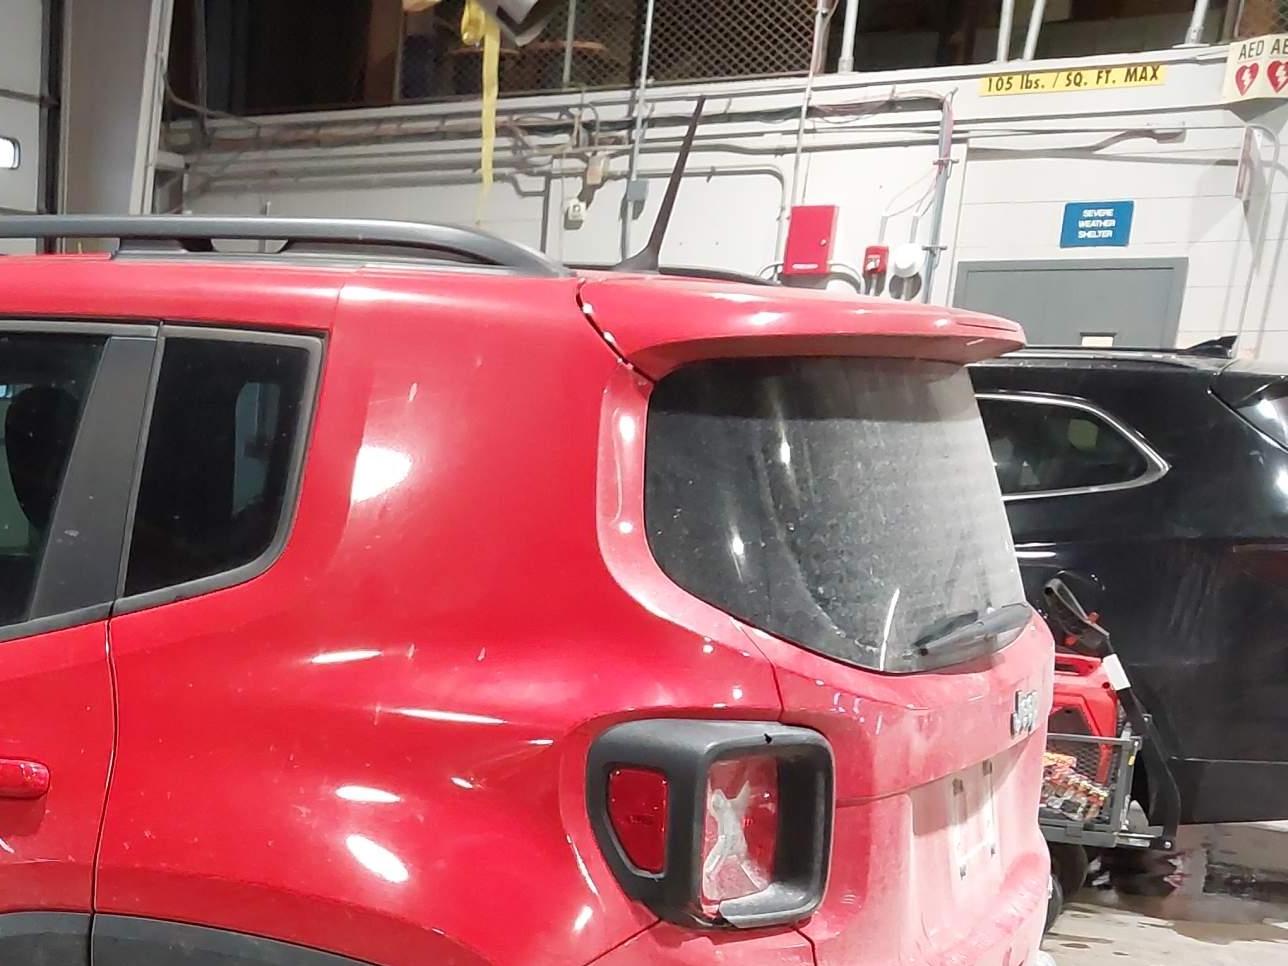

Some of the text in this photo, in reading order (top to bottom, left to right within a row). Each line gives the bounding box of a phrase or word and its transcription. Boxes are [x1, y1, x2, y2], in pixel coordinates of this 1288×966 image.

[1239, 40, 1265, 60] AED
[987, 65, 1160, 92] 105 lbs. / SQ. FT. MAX
[1082, 208, 1114, 217] SEVERE
[1078, 219, 1116, 228] WEATHER
[1078, 230, 1113, 239] SHELTER
